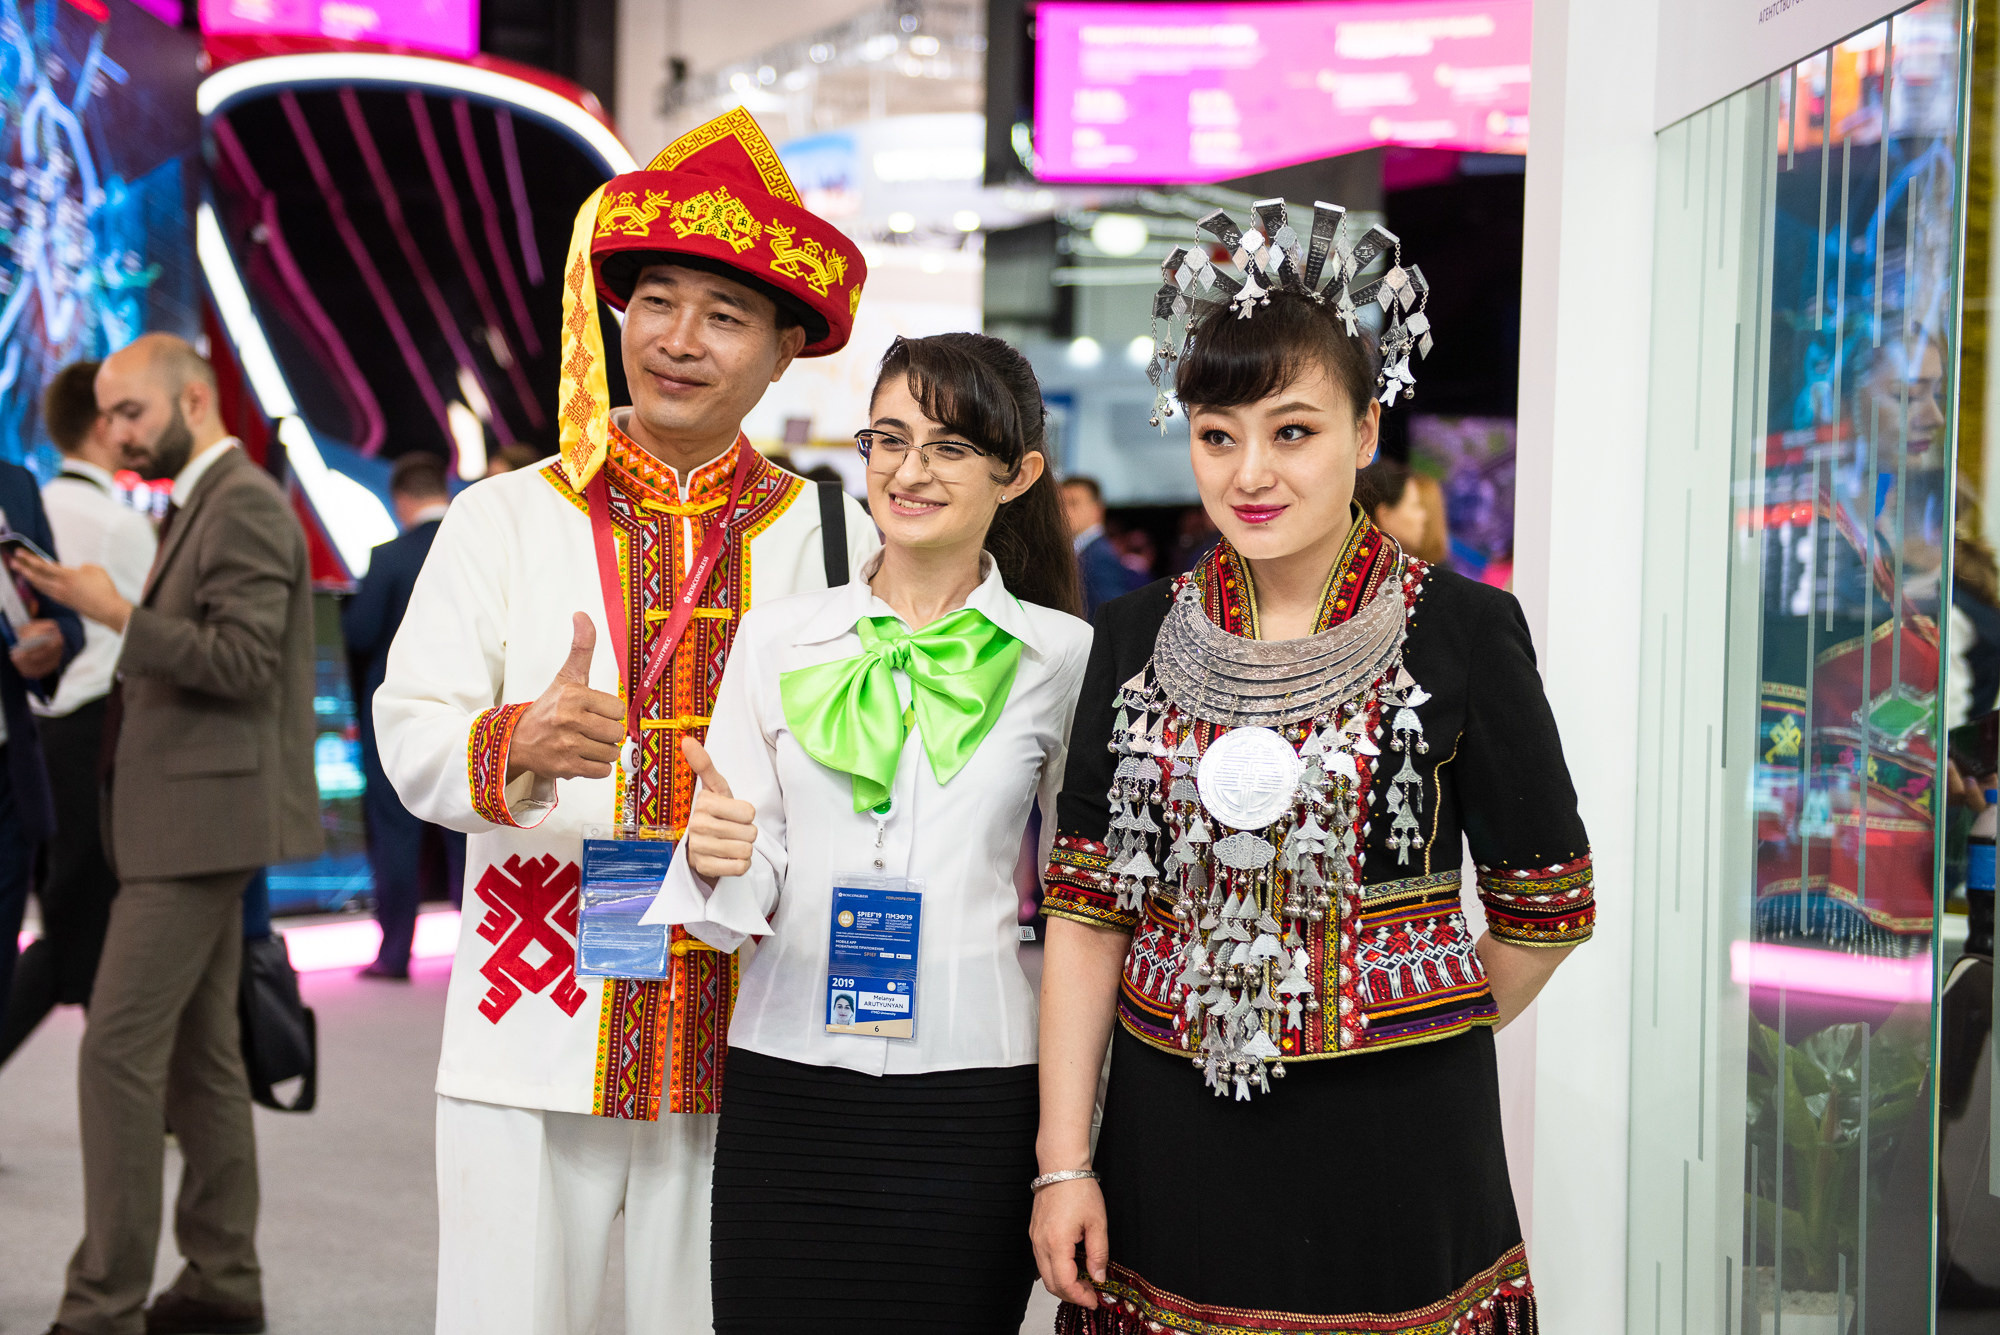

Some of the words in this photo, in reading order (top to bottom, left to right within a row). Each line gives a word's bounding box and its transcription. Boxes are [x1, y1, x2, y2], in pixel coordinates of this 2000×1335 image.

[687, 556, 709, 598] ROSCONGRESS
[647, 636, 673, 682] РОСКОНГРЕСС
[857, 910, 882, 918] SPIEF'19
[832, 977, 855, 988] 2019
